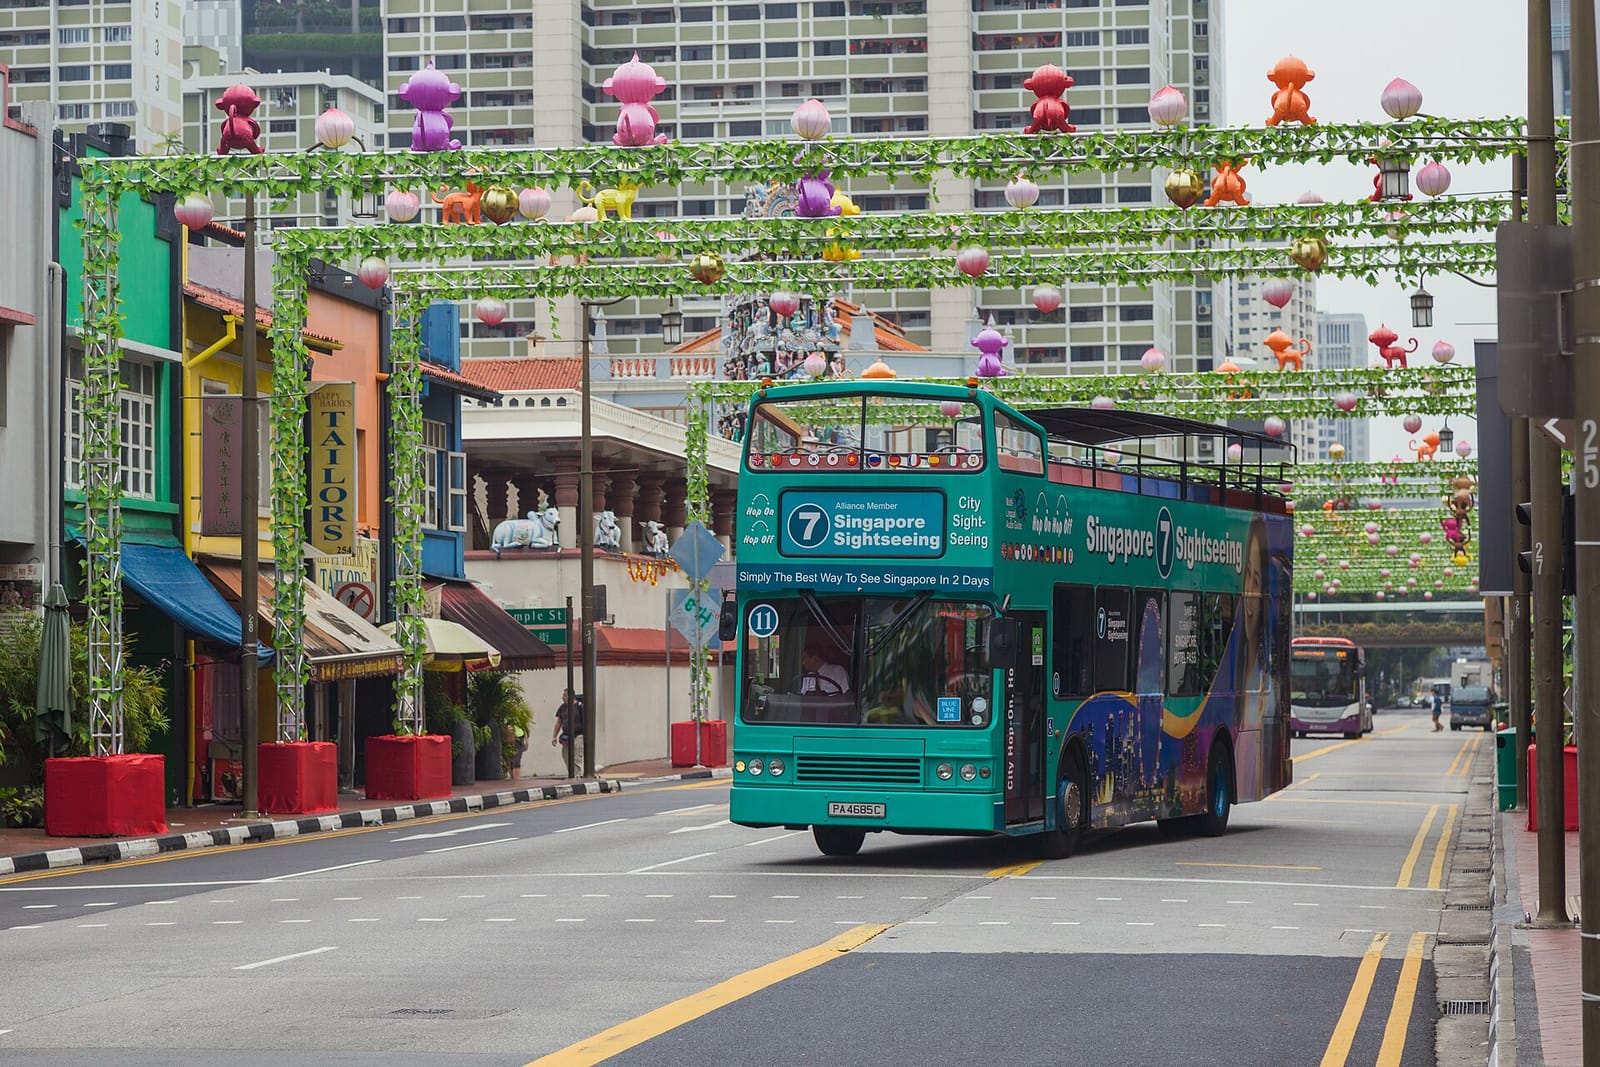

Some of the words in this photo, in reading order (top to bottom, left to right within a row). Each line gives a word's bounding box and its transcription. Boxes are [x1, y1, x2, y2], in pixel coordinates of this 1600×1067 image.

[314, 392, 340, 401] HAPPY
[319, 399, 353, 408] HARRY'S
[1582, 419, 1599, 489] 25
[319, 411, 347, 541] TAILORS
[746, 506, 762, 518] Hop
[763, 507, 775, 516] On
[835, 502, 865, 510] Alliance
[866, 502, 898, 510] Member
[958, 495, 981, 513] City
[798, 511, 821, 541] 7
[833, 513, 926, 532] Singapore
[952, 513, 987, 530] Sight-
[1032, 514, 1043, 536] Hop
[1044, 515, 1052, 533] On
[1052, 516, 1063, 538] Hop
[1063, 517, 1073, 535] Off
[743, 535, 759, 546] Hop
[760, 534, 775, 544] Off
[833, 530, 940, 550] Sightseeing
[950, 531, 988, 549] Seeing
[1086, 514, 1154, 563] Singapore
[1160, 520, 1170, 566] 7
[1176, 525, 1243, 574] Sightseeing
[336, 545, 352, 554] 254
[1535, 542, 1544, 575] 27
[739, 571, 772, 584] Simply
[773, 571, 793, 582] The
[795, 572, 818, 583] Best
[819, 572, 843, 585] Way
[845, 573, 858, 583] To
[860, 573, 881, 584] See
[883, 573, 937, 587] Singapore
[939, 574, 950, 585] In
[952, 575, 959, 585] 2
[962, 575, 990, 587] Days
[514, 610, 543, 623] mple
[549, 609, 562, 621] St
[755, 611, 773, 630] 11
